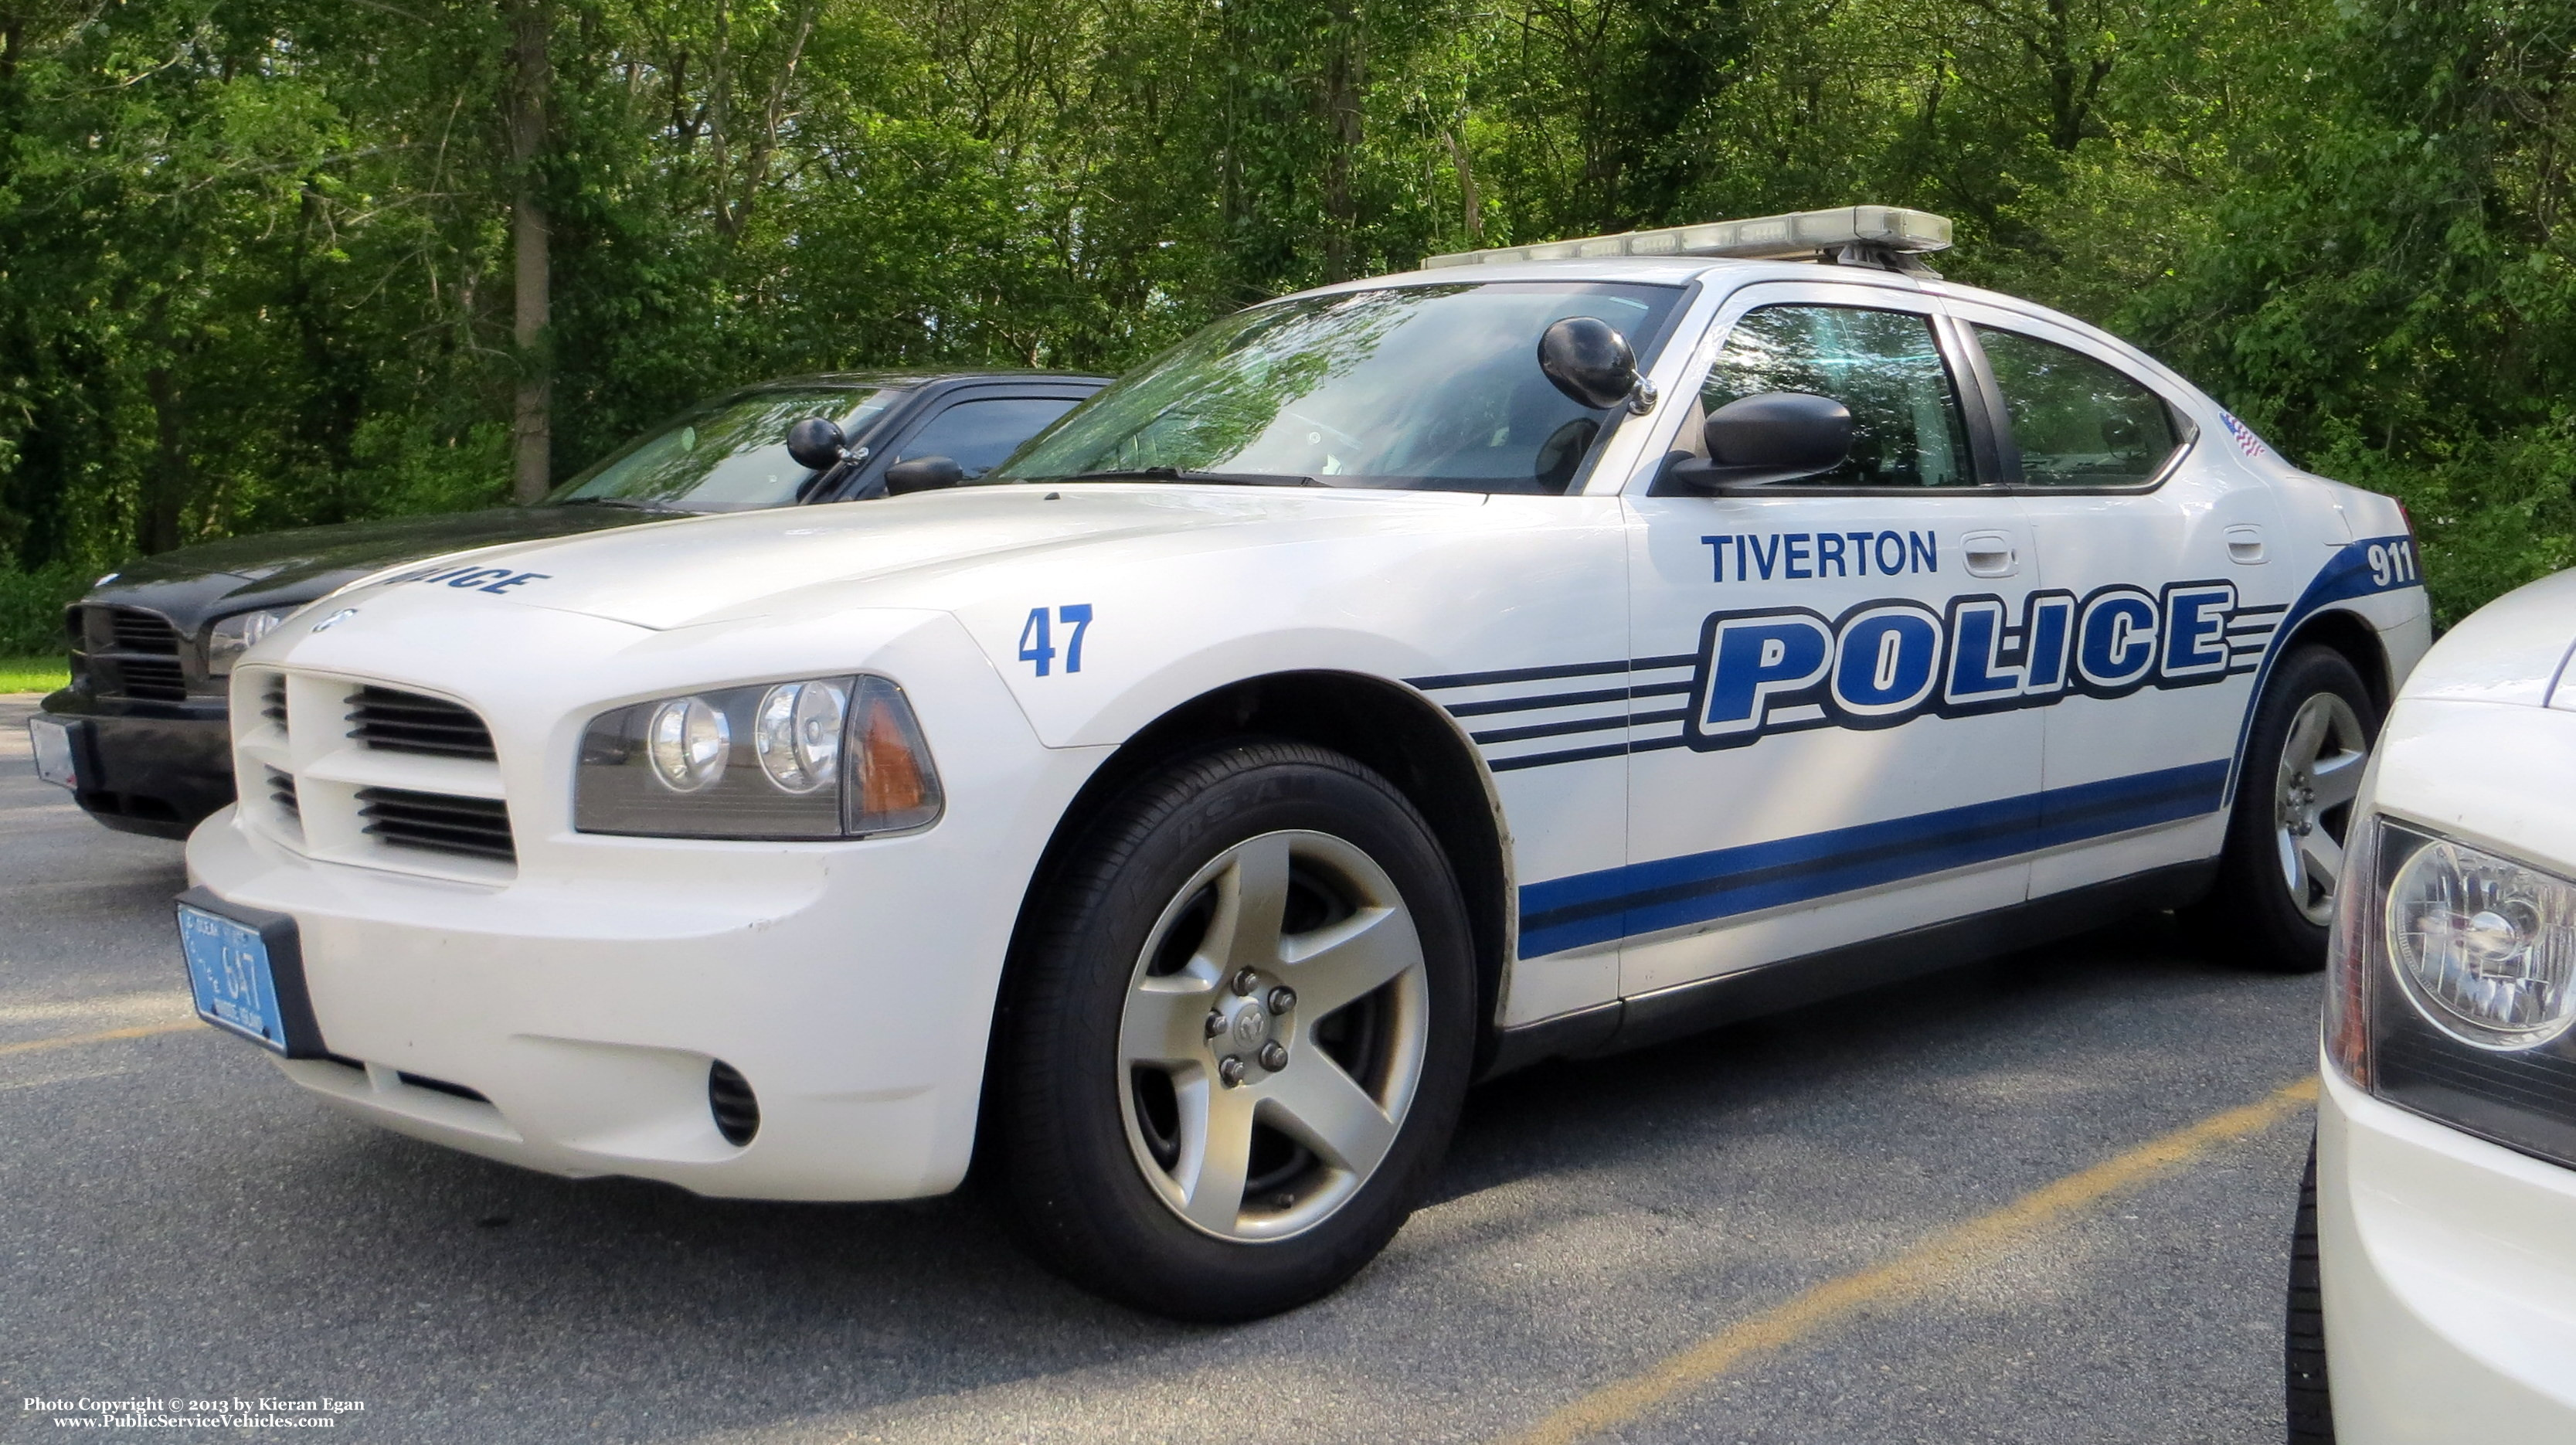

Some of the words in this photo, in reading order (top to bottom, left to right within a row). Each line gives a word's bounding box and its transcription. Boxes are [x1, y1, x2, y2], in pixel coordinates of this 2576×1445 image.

[1701, 530, 1937, 583] TIVERTON
[2367, 541, 2415, 587] 911
[1018, 604, 1093, 677] 47
[1692, 580, 2238, 746] POLICE
